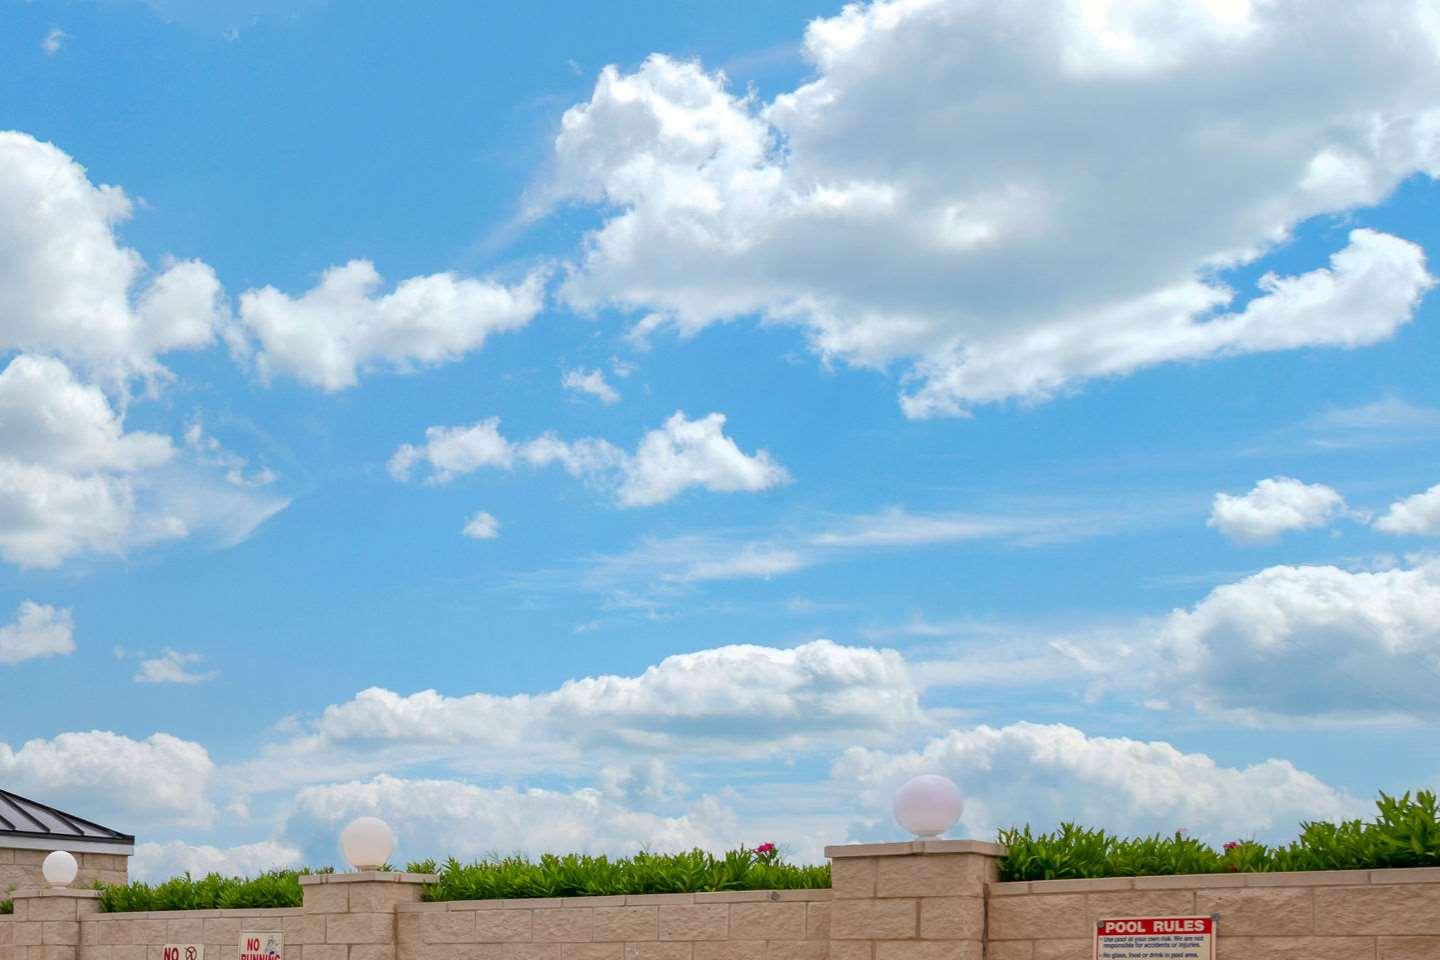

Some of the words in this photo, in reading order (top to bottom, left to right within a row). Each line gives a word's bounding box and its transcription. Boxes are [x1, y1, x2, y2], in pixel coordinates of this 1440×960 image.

[1105, 921, 1146, 933] POOL
[1153, 920, 1205, 932] RULES
[246, 938, 260, 952] NO
